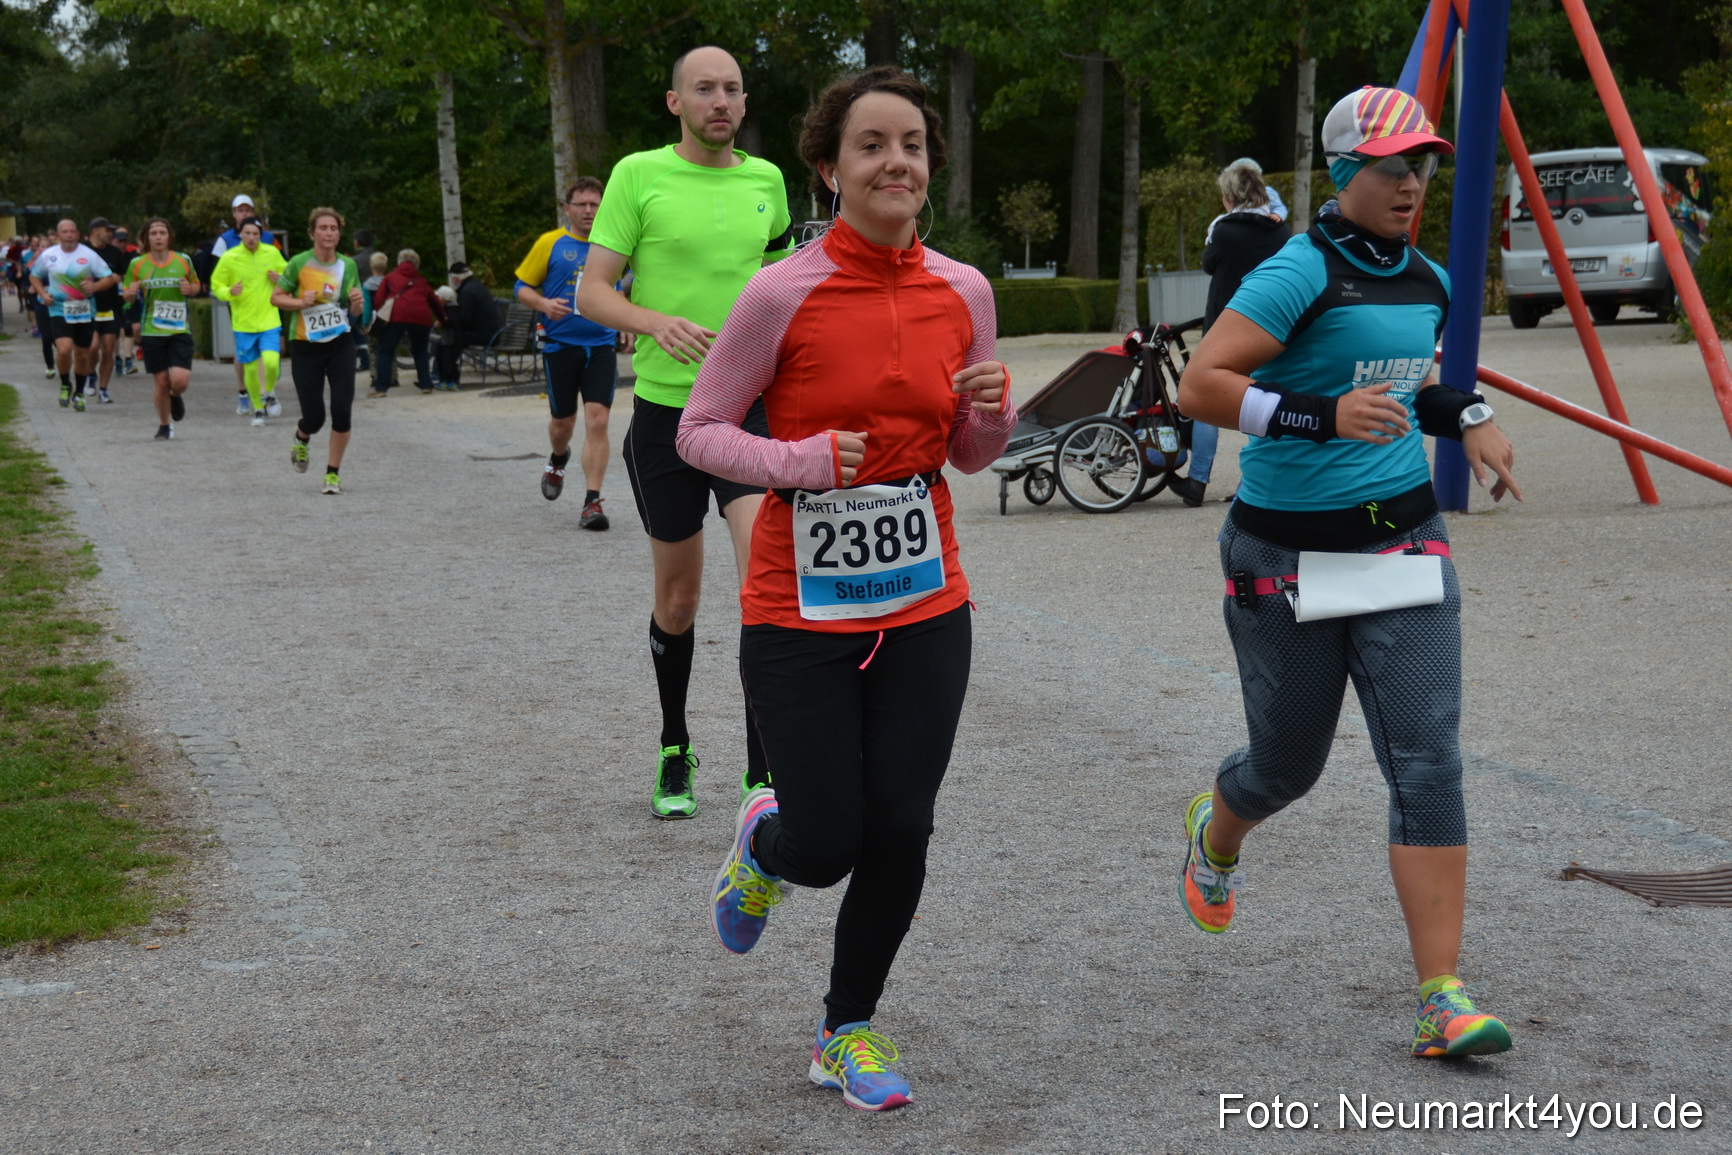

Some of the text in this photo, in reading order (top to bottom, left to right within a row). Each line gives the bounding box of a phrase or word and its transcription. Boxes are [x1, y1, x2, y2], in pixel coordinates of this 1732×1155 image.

[157, 307, 184, 319] 2747
[309, 311, 341, 330] 2475
[1353, 358, 1434, 382] HUBER
[797, 492, 914, 514] PARTL Neumarkt
[809, 508, 928, 568] 2389
[835, 575, 912, 599] Stefanie
